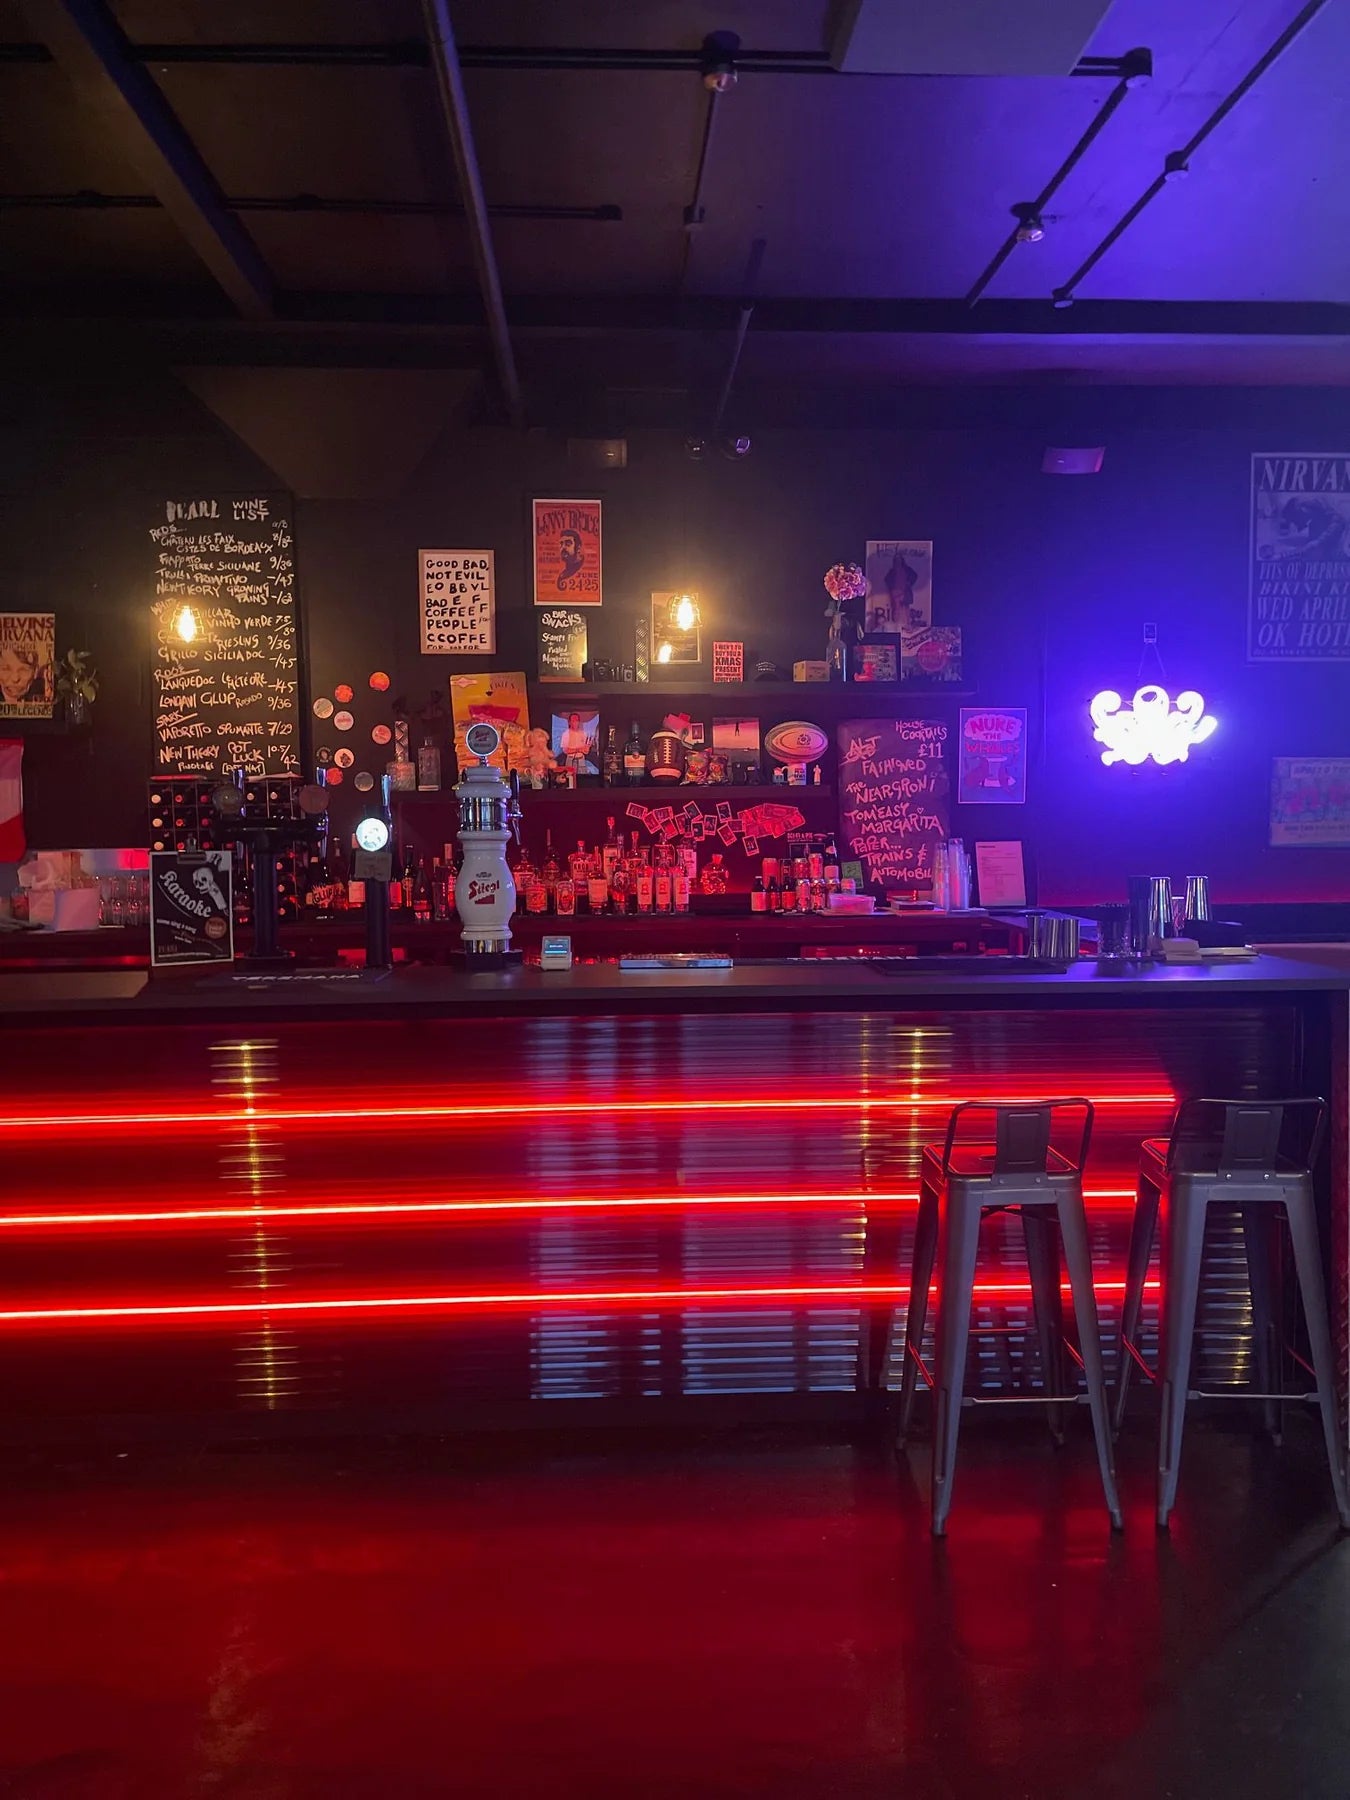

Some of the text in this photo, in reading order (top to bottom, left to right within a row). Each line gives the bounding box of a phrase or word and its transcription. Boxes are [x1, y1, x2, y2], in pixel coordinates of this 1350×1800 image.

[232, 499, 268, 511] WINE
[234, 510, 270, 522] LIST
[224, 540, 273, 555] BORDEAUX
[426, 560, 458, 569] GOOD
[426, 571, 485, 580] NOT EVIL
[425, 598, 448, 608] BAD
[0, 616, 54, 629] ELVINS
[427, 619, 477, 630] PEOPLE
[541, 613, 582, 629] SNACKS
[0, 630, 54, 641] RVANA
[1258, 623, 1289, 647] OK
[715, 657, 742, 666] XMAS
[200, 691, 237, 707] GLUP
[970, 717, 1017, 735] NUKE
[160, 741, 252, 764] NEW THEORY POT
[232, 749, 265, 763] LUCK
[918, 742, 944, 758] £11
[859, 848, 913, 867] TRAINS
[870, 867, 932, 885] AUTOMOBIL
[160, 871, 212, 917] Karaoke
[469, 880, 499, 899] Stiegl
